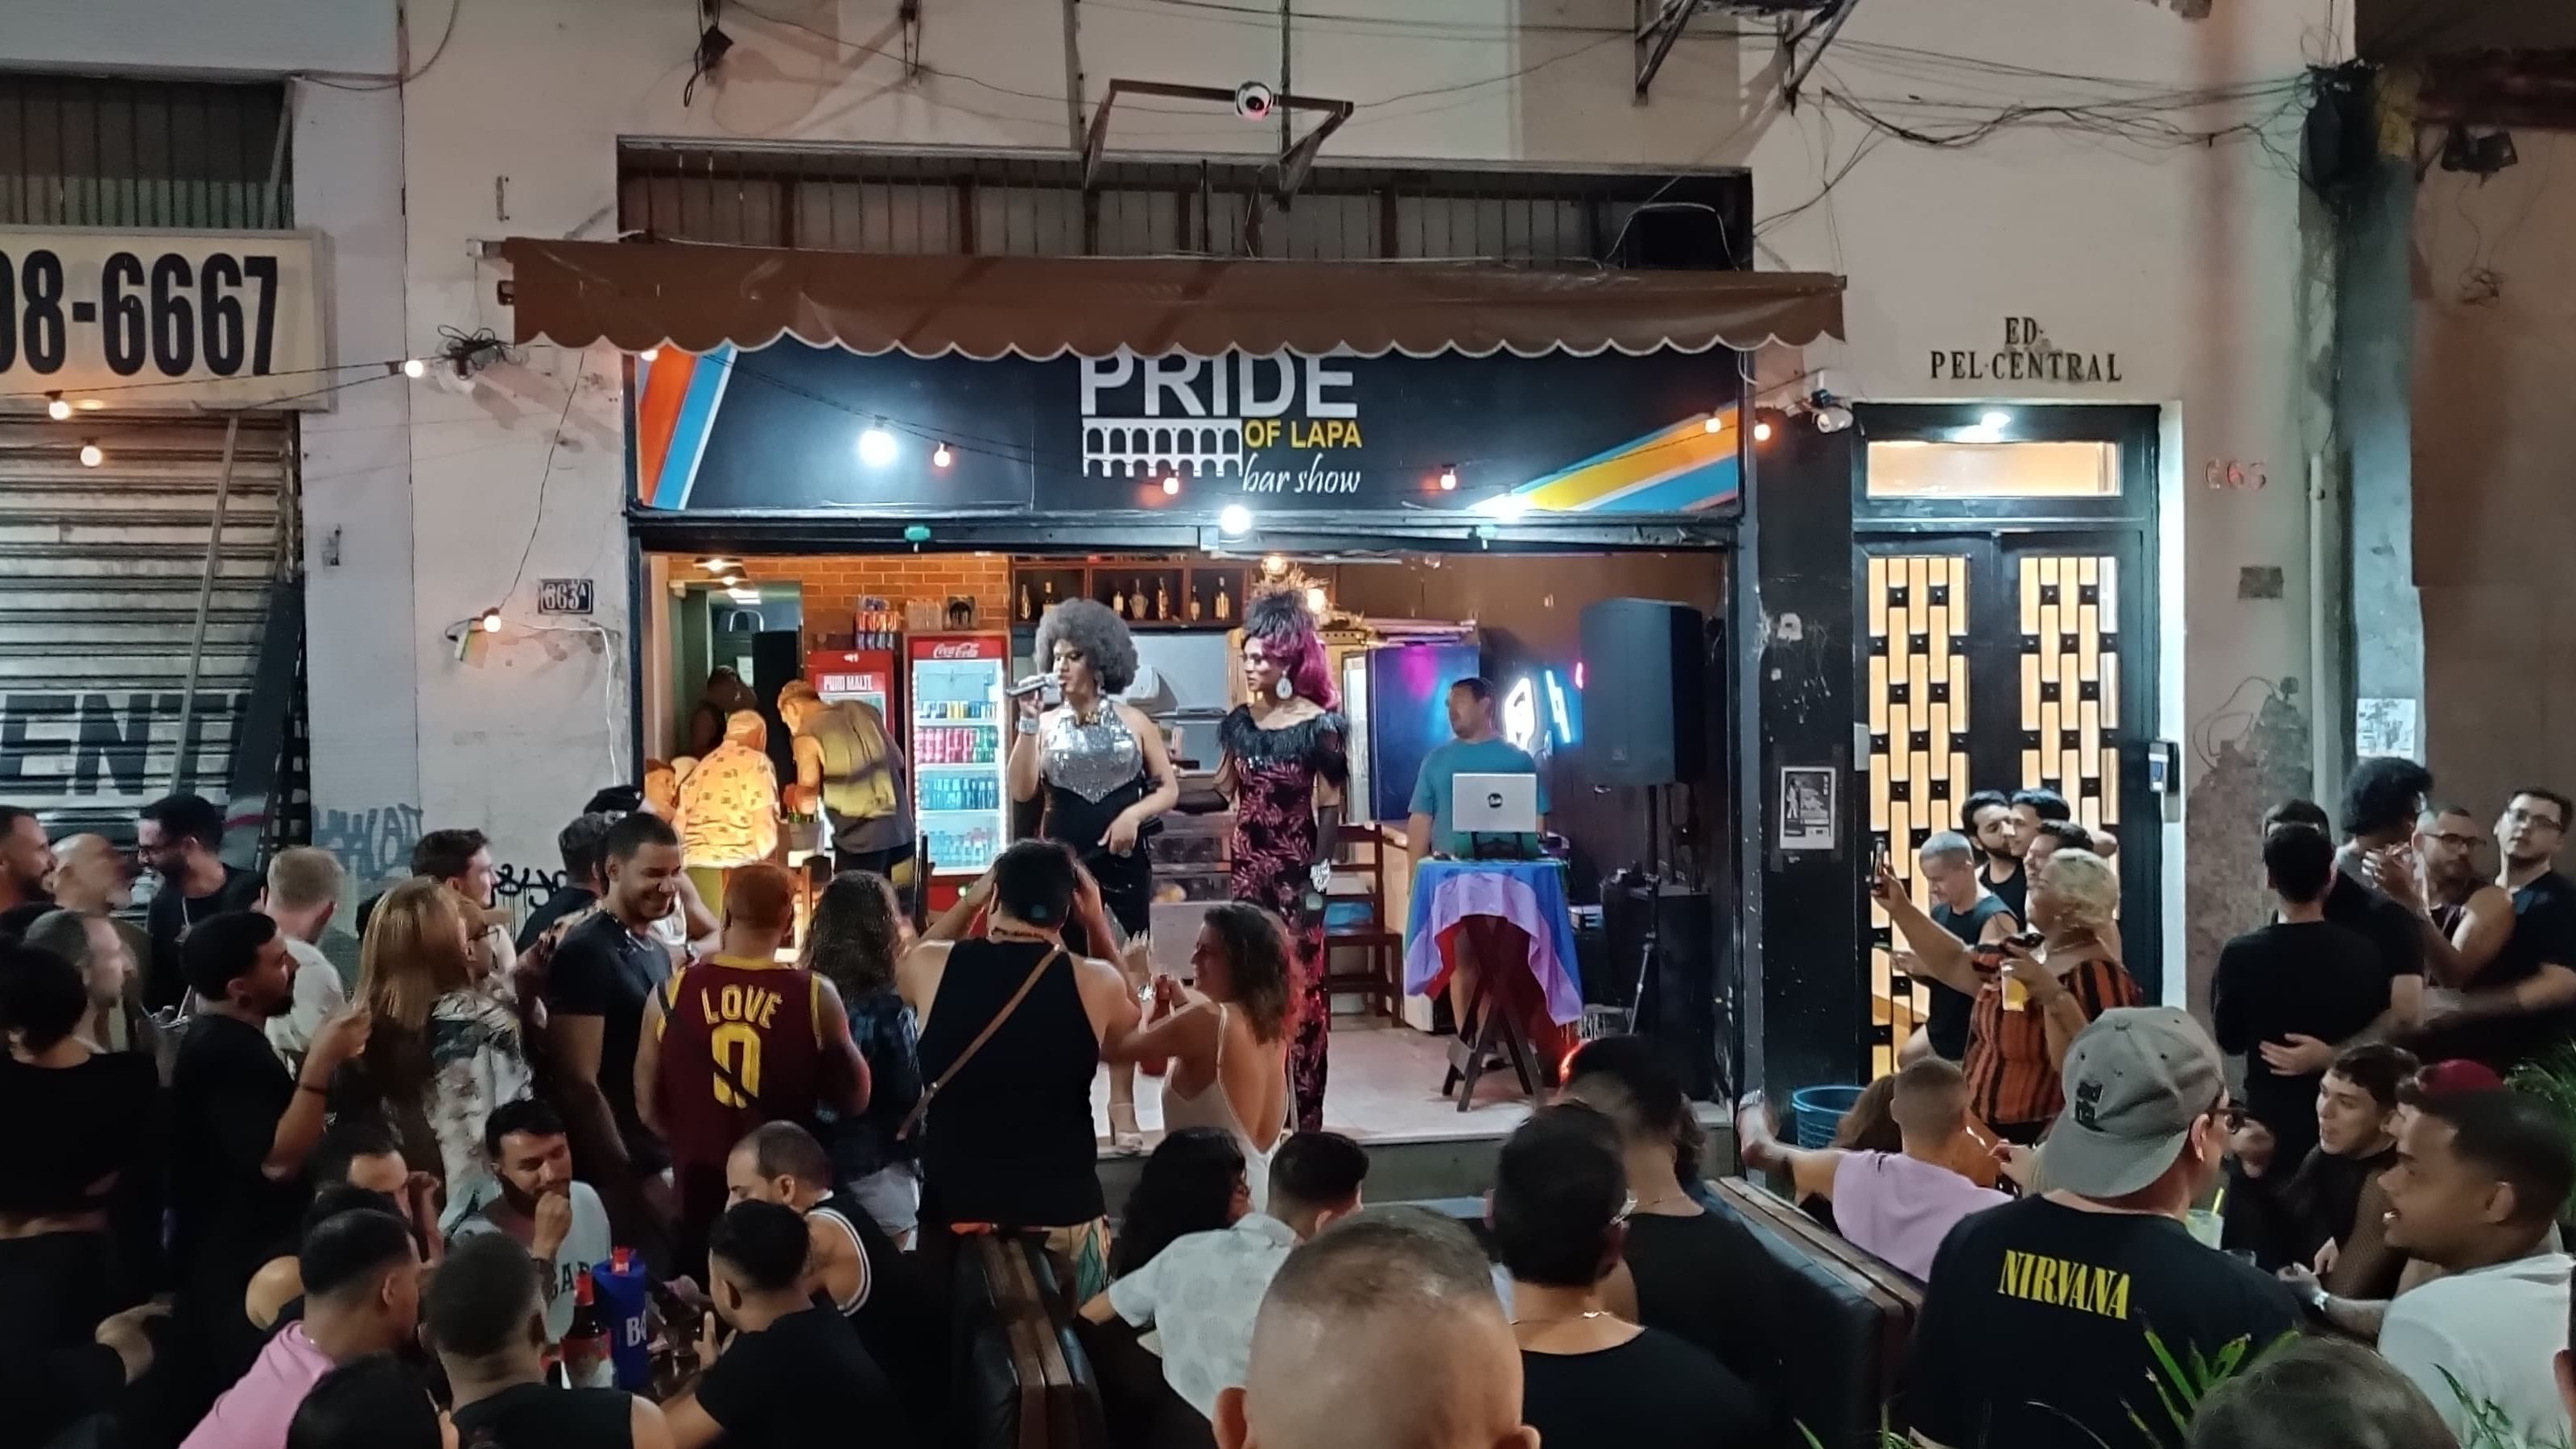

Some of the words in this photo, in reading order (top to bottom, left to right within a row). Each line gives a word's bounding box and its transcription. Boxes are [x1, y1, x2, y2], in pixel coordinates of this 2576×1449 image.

[1080, 346, 1358, 418] PRIDE
[1244, 419, 1282, 448] OF
[1290, 420, 1363, 448] LAPA
[1242, 452, 1290, 493] bar
[1294, 452, 1361, 493] show
[701, 984, 783, 1029] LOVE
[1997, 1249, 2130, 1320] NIRVANA
